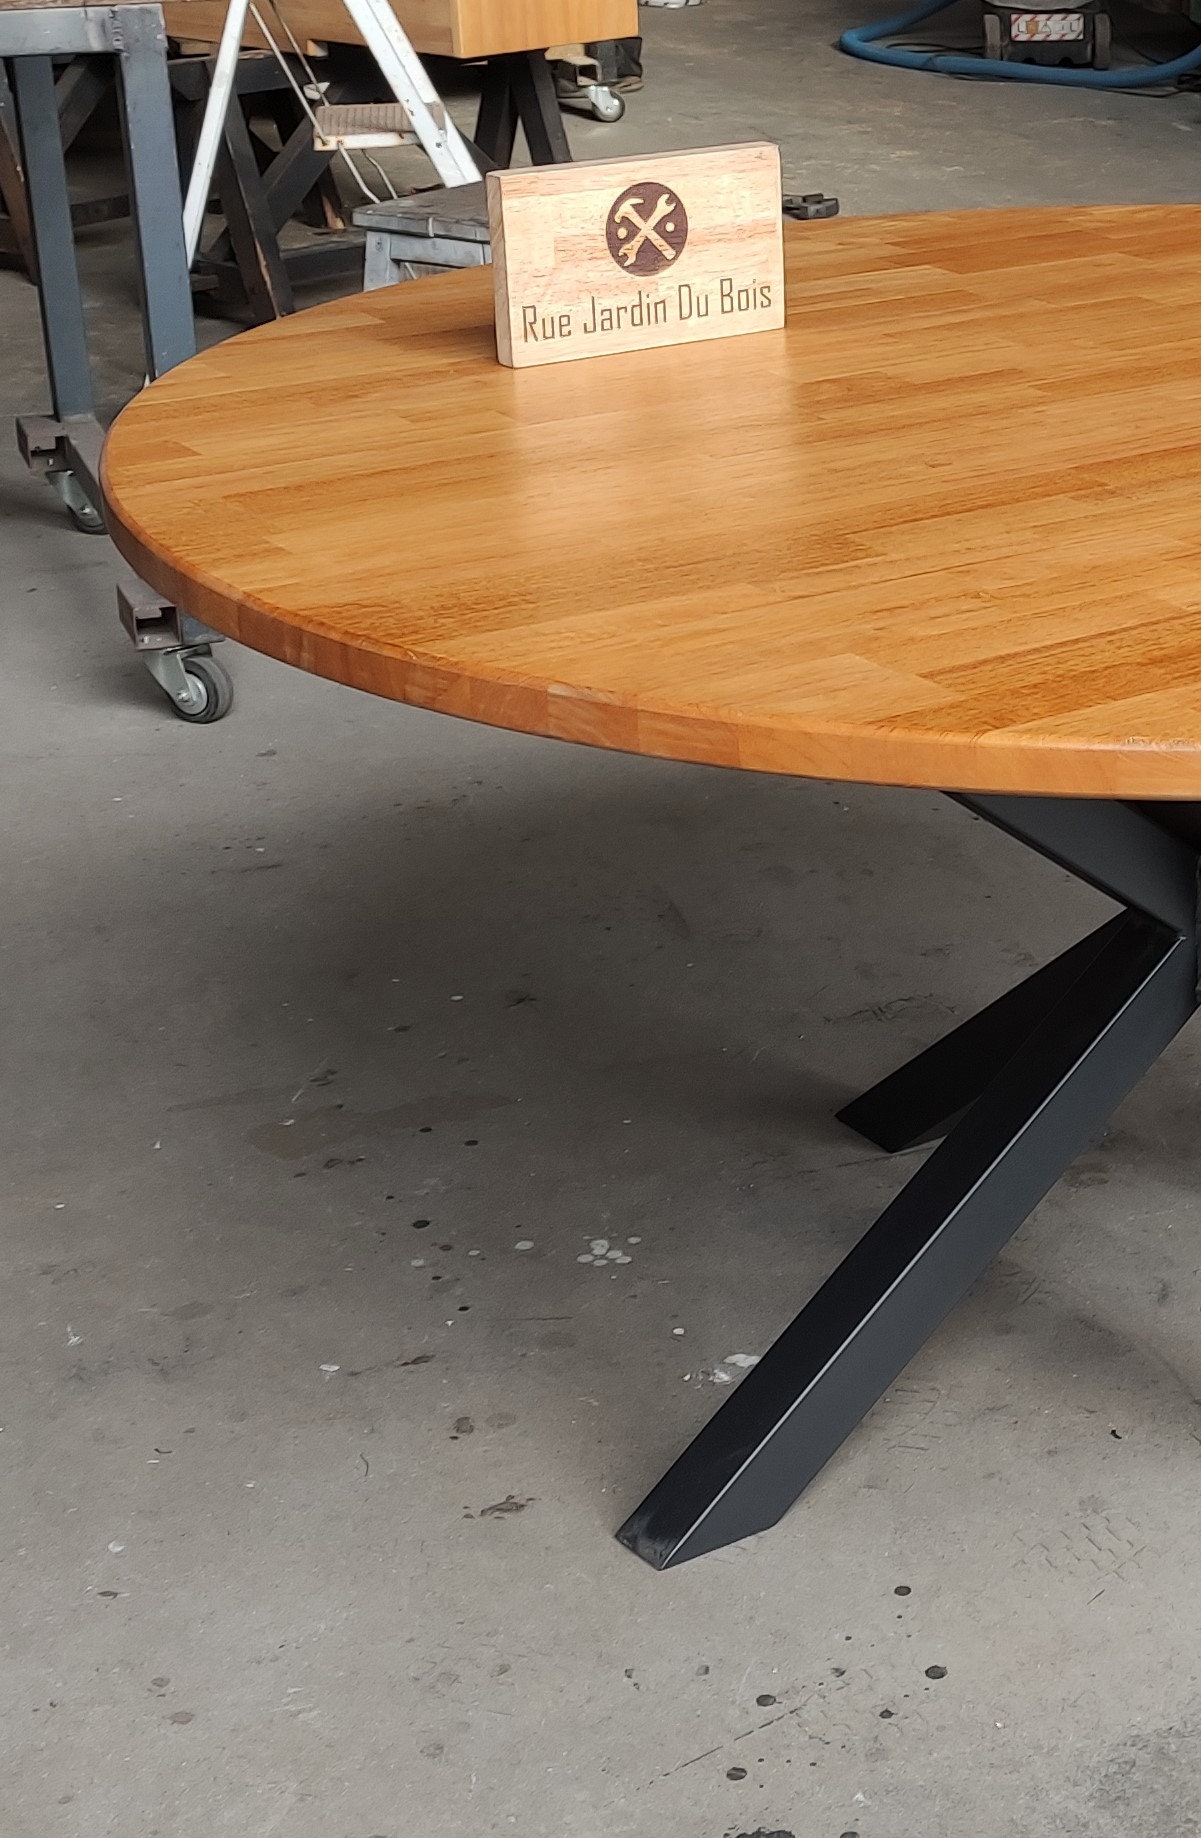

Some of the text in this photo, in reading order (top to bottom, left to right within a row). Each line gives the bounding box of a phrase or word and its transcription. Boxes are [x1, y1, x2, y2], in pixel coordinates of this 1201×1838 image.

[521, 277, 772, 343] Rue Jardin Du Bois
